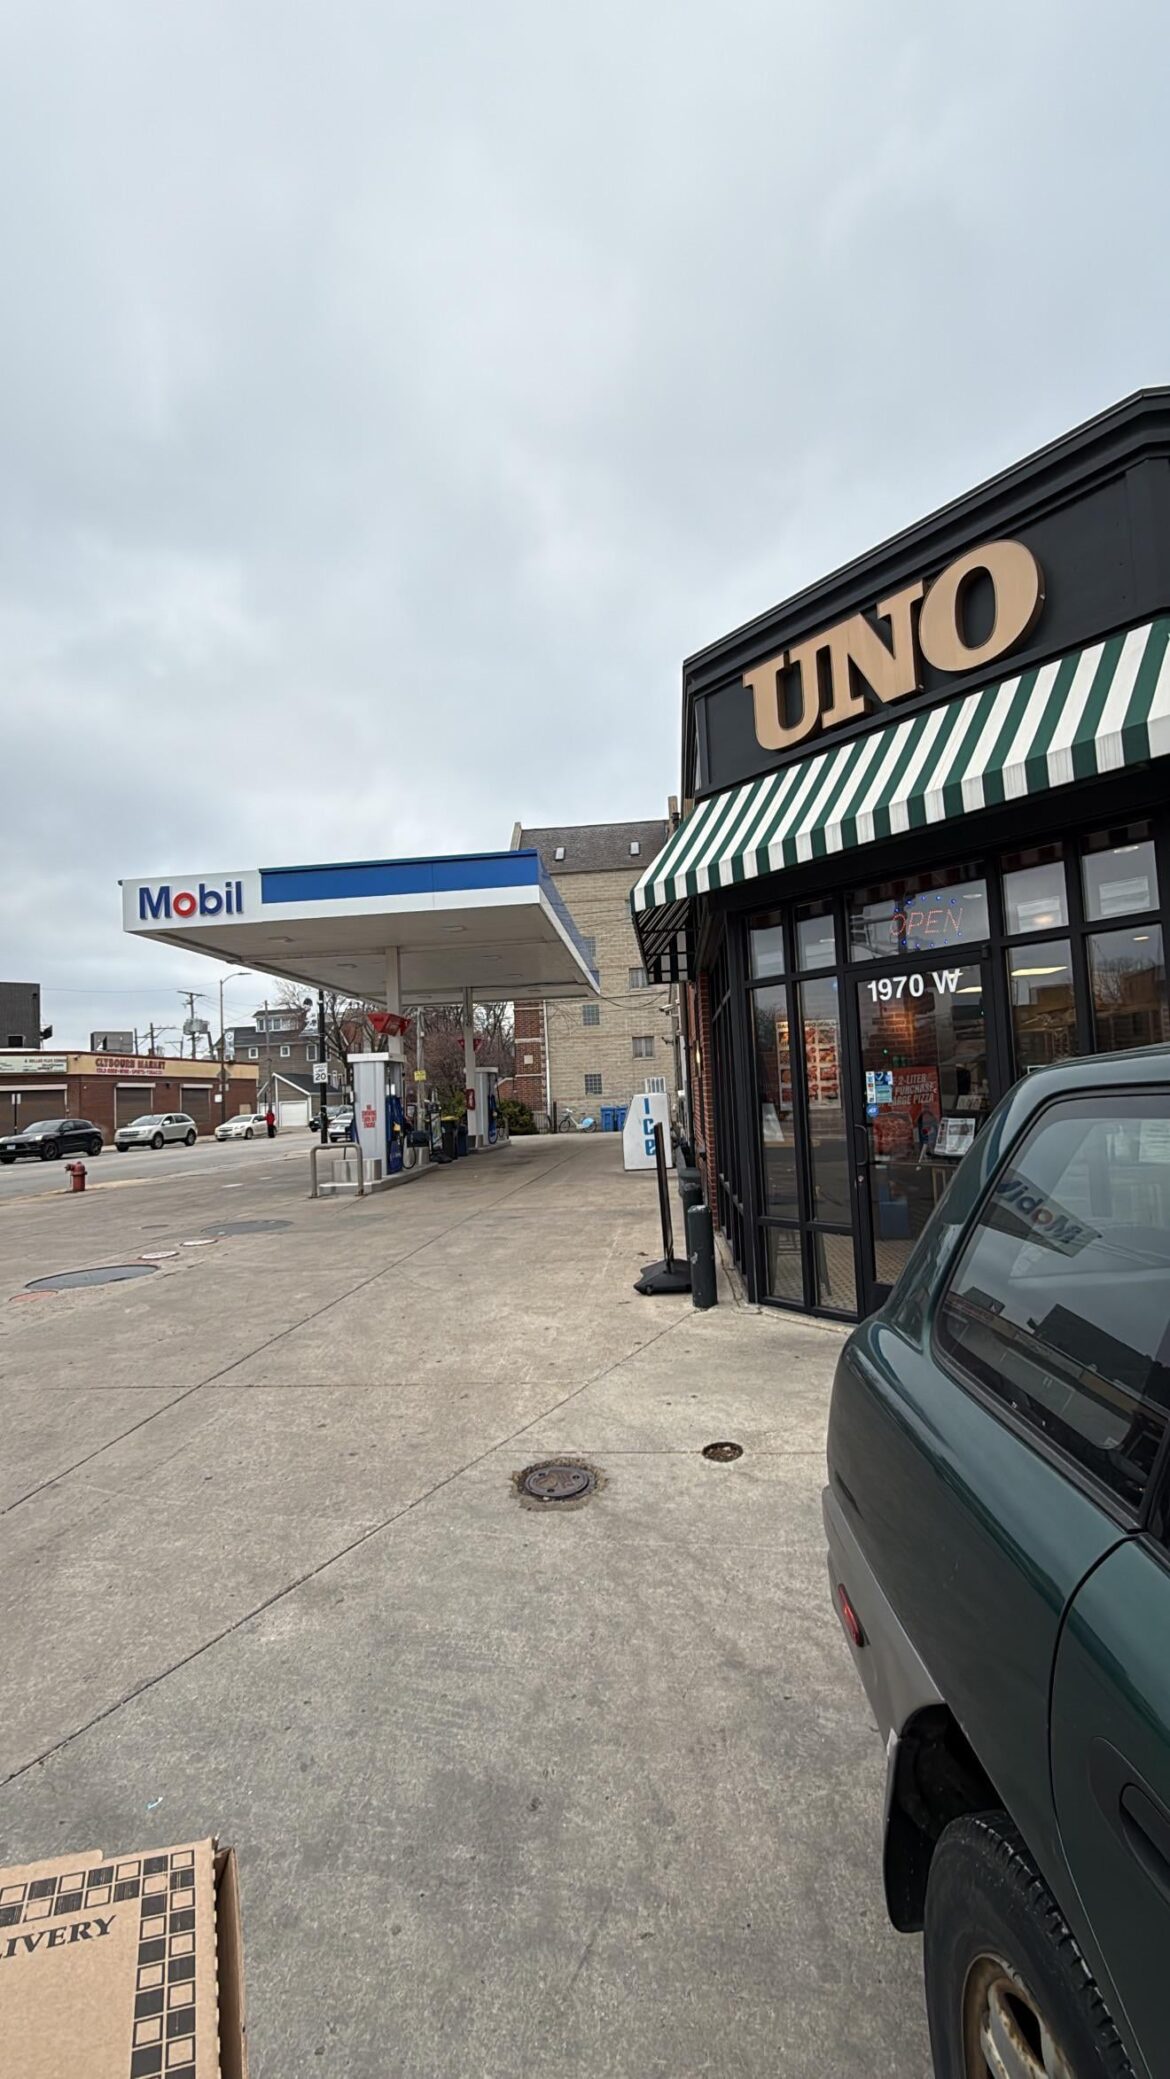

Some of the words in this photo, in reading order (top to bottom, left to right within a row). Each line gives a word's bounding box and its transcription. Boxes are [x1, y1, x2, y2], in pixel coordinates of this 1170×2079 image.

[742, 538, 1042, 752] UNO
[139, 880, 243, 920] Mobil
[889, 907, 963, 936] OPEN
[867, 973, 924, 1002] 1970
[931, 967, 961, 995] W
[315, 1072, 327, 1081] 20
[913, 1093, 935, 1104] PIZZA
[0, 1914, 117, 1960] IVERY
